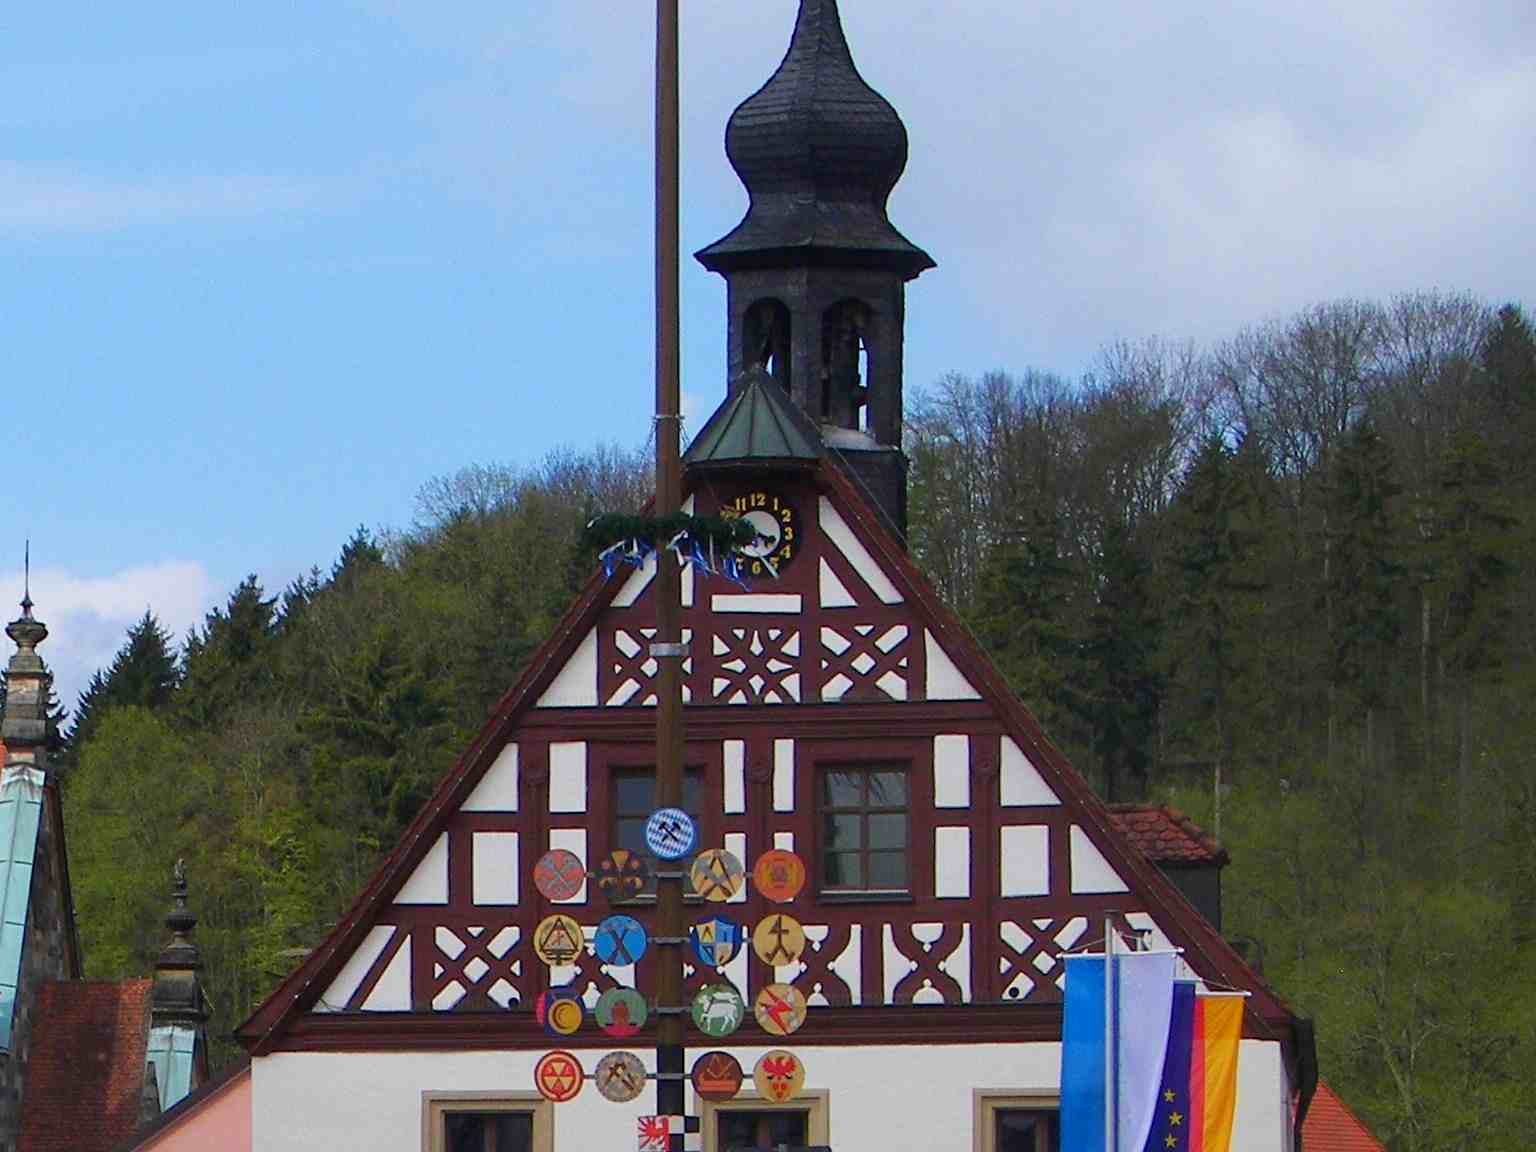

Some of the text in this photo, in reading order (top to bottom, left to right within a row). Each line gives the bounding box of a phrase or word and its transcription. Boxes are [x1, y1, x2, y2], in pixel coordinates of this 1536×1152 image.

[736, 497, 746, 510] 11
[751, 493, 766, 507] 12
[781, 509, 791, 522] 2
[784, 527, 792, 540] 3
[751, 561, 761, 574] 6
